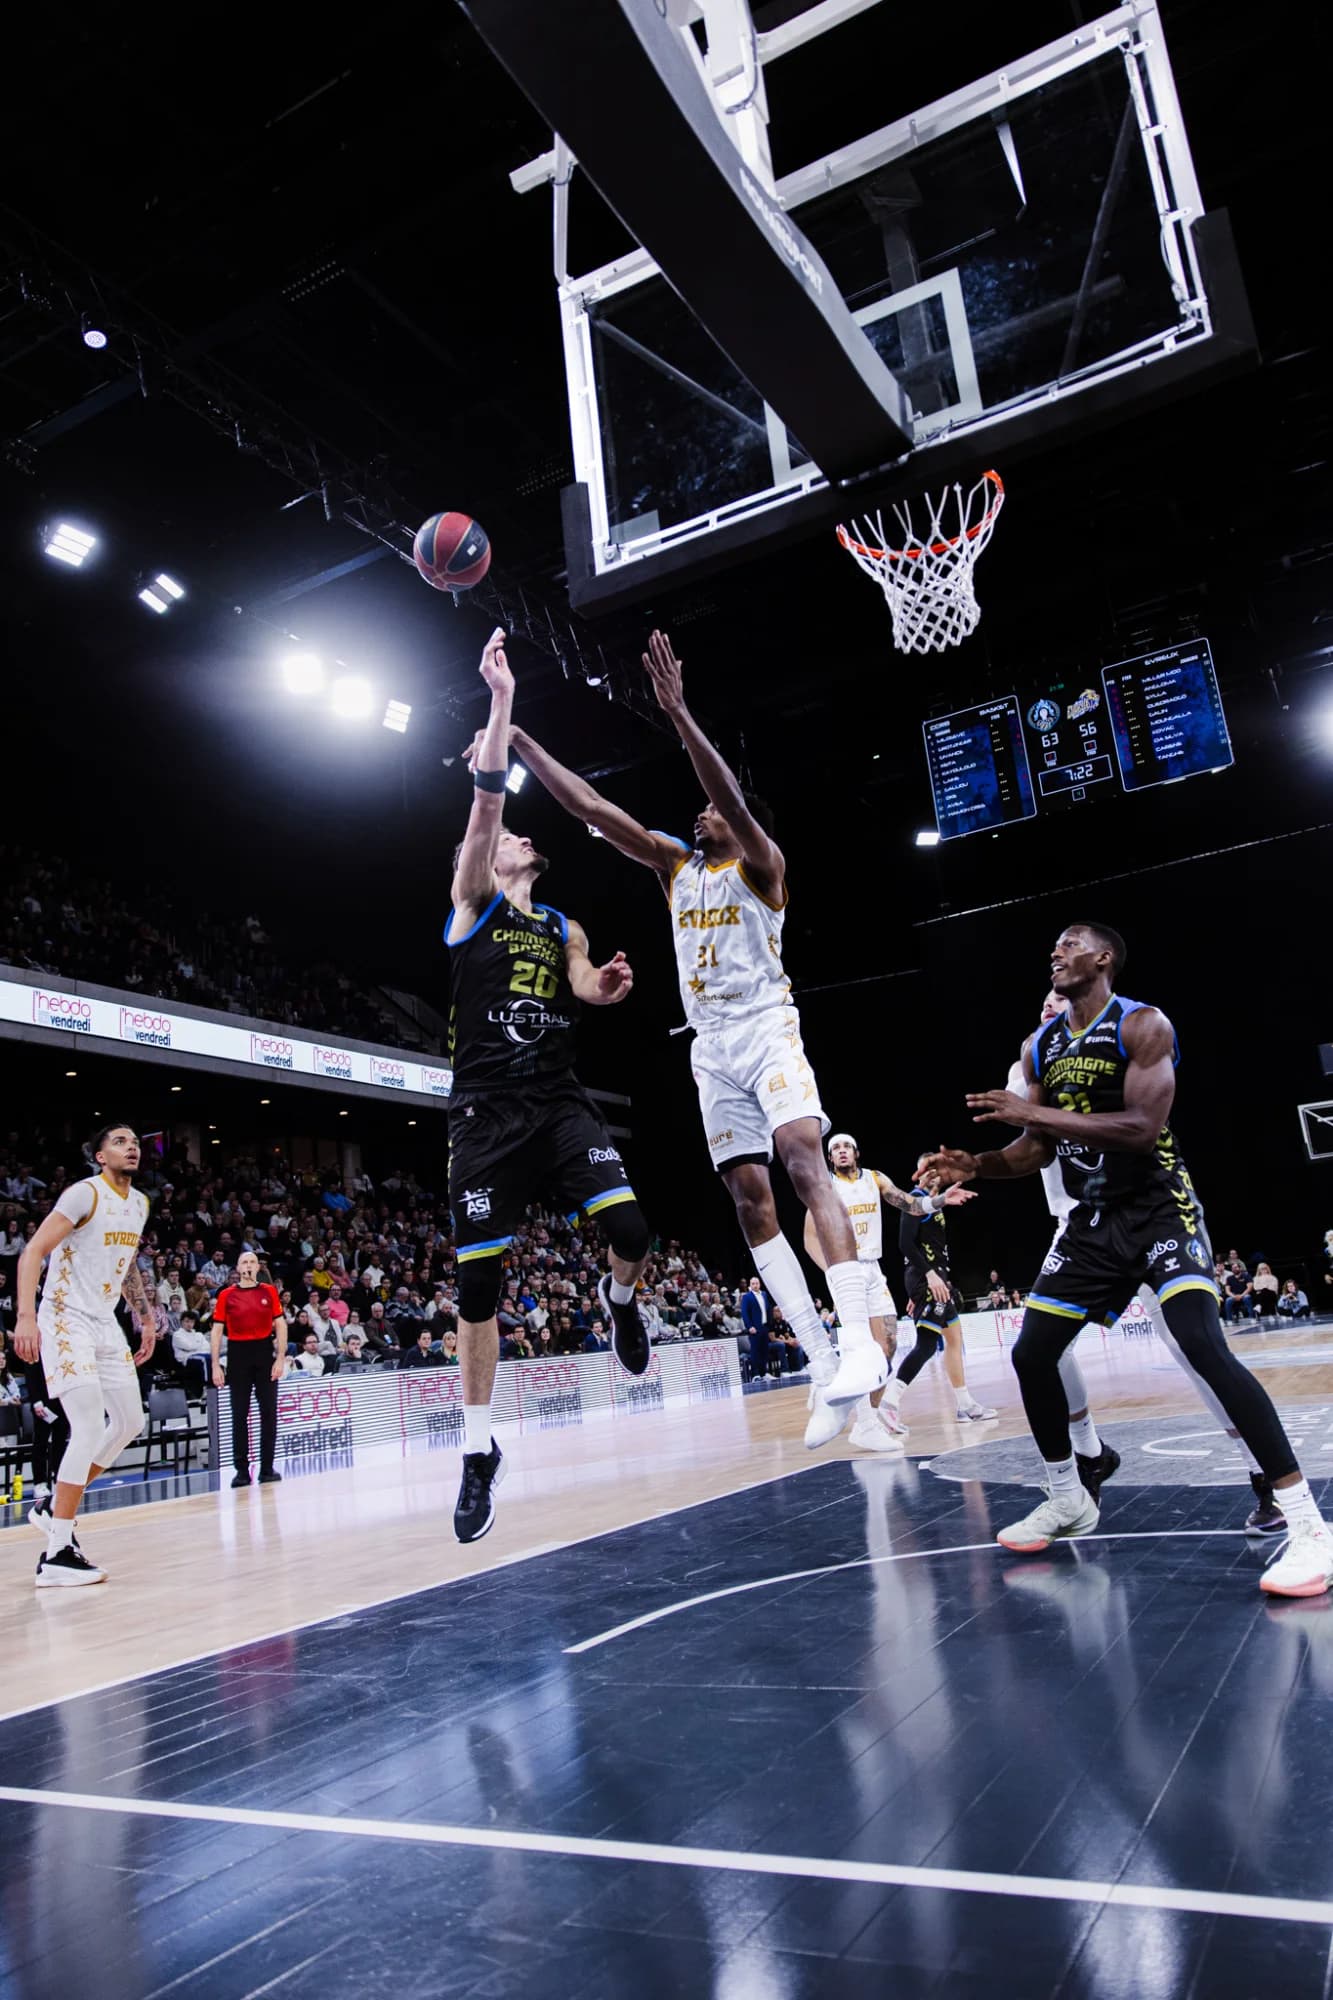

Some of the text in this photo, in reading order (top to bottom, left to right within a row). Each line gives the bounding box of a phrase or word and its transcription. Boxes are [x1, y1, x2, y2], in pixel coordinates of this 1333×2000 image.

[1080, 721, 1097, 737] 56
[1041, 732, 1059, 748] 63
[1065, 764, 1093, 781] 7:22
[510, 960, 559, 999] 20
[51, 1015, 91, 1032] vendredi
[488, 1010, 571, 1025] LUSTRAL
[135, 1029, 171, 1046] vendredi
[263, 1054, 293, 1068] vendredi
[466, 1198, 492, 1216] ASI
